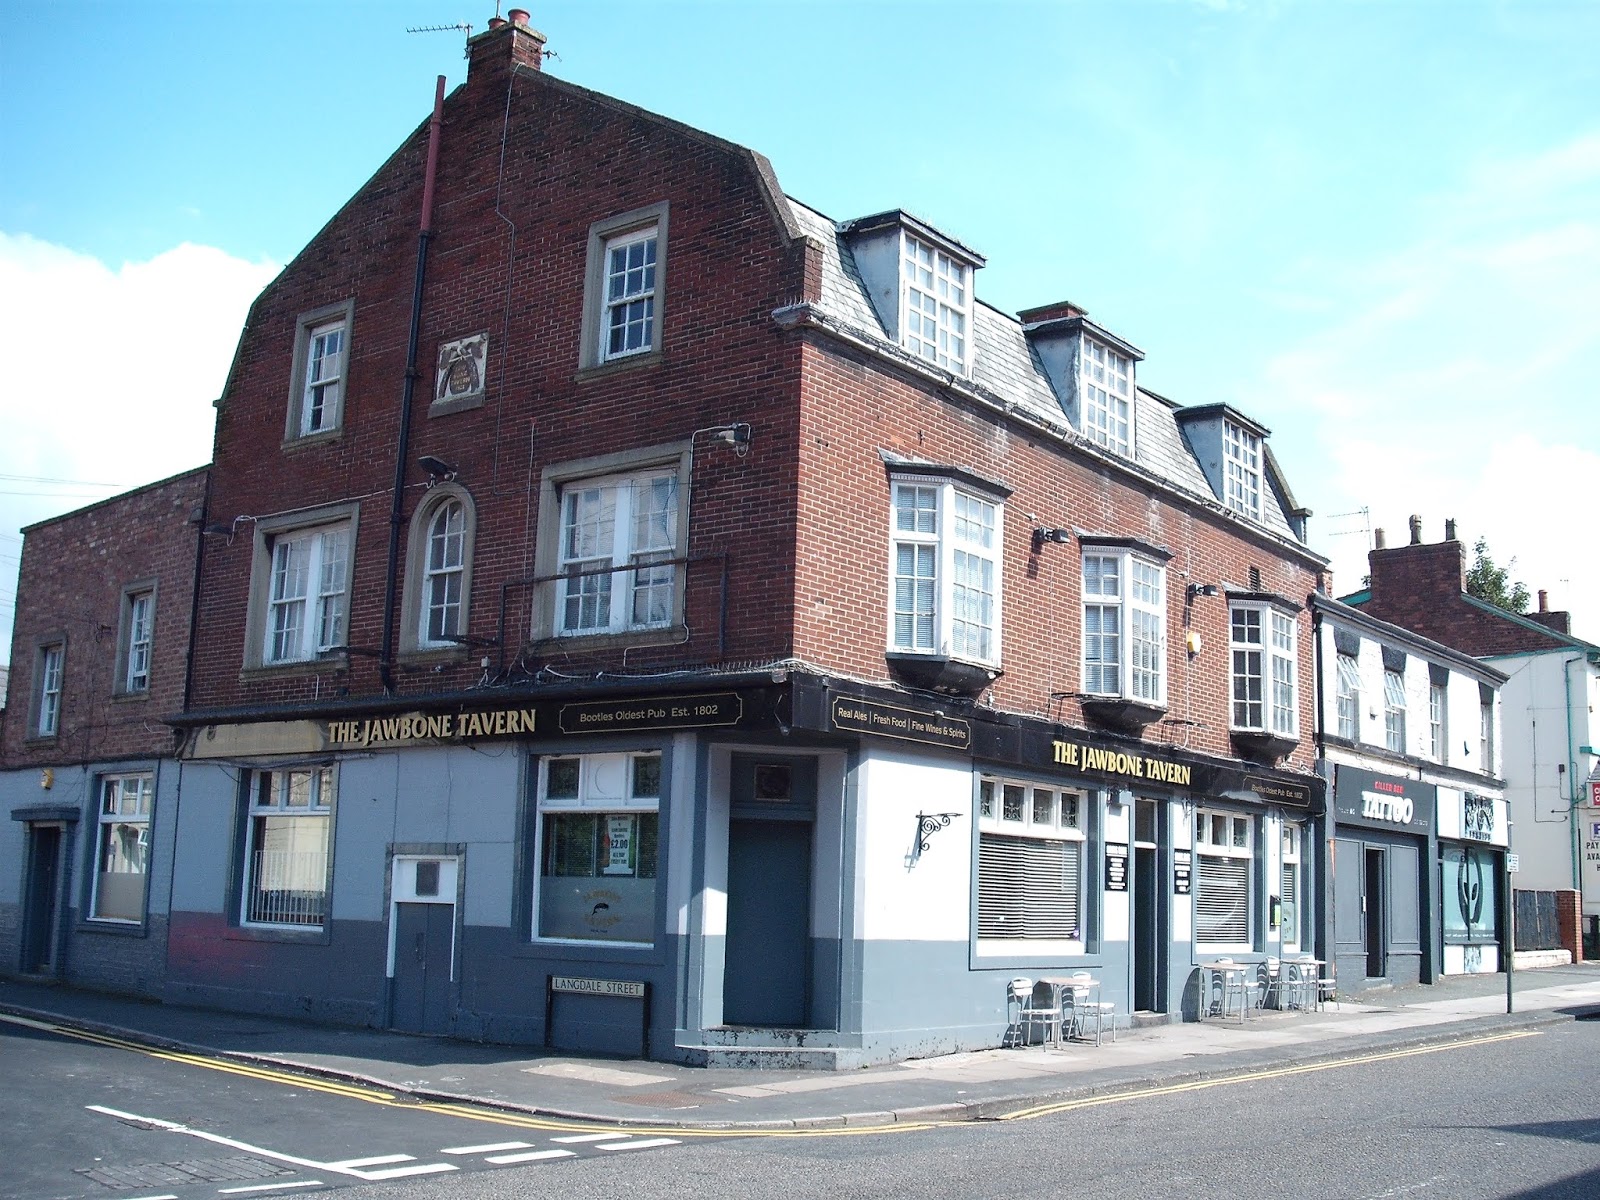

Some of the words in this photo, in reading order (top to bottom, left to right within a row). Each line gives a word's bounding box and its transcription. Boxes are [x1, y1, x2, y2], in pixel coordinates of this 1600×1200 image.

[580, 712, 614, 722] Bootles
[615, 710, 645, 720] Oldest
[647, 708, 666, 719] Pub
[671, 707, 690, 717] Est.
[694, 704, 718, 716] 1802
[328, 720, 360, 743] THE
[362, 714, 452, 747] JAWBONE
[457, 708, 536, 737] TAVERN
[838, 707, 853, 719] Real
[853, 710, 868, 721] Ales
[873, 713, 891, 725] Fresh
[891, 717, 907, 728] Food
[911, 720, 925, 731] Fine
[925, 723, 942, 735] Wines
[943, 726, 950, 735] &
[949, 727, 967, 739] Spirits
[1052, 740, 1079, 766] THE
[1080, 746, 1143, 777] JAWBONE
[1145, 758, 1191, 785] TAVERN
[1277, 788, 1285, 796] Pub
[1361, 790, 1414, 825] TATTOO
[611, 839, 628, 849] £2.00
[1586, 841, 1599, 850] PAY
[555, 978, 602, 992] LANGDALE
[606, 982, 640, 995] STREET
